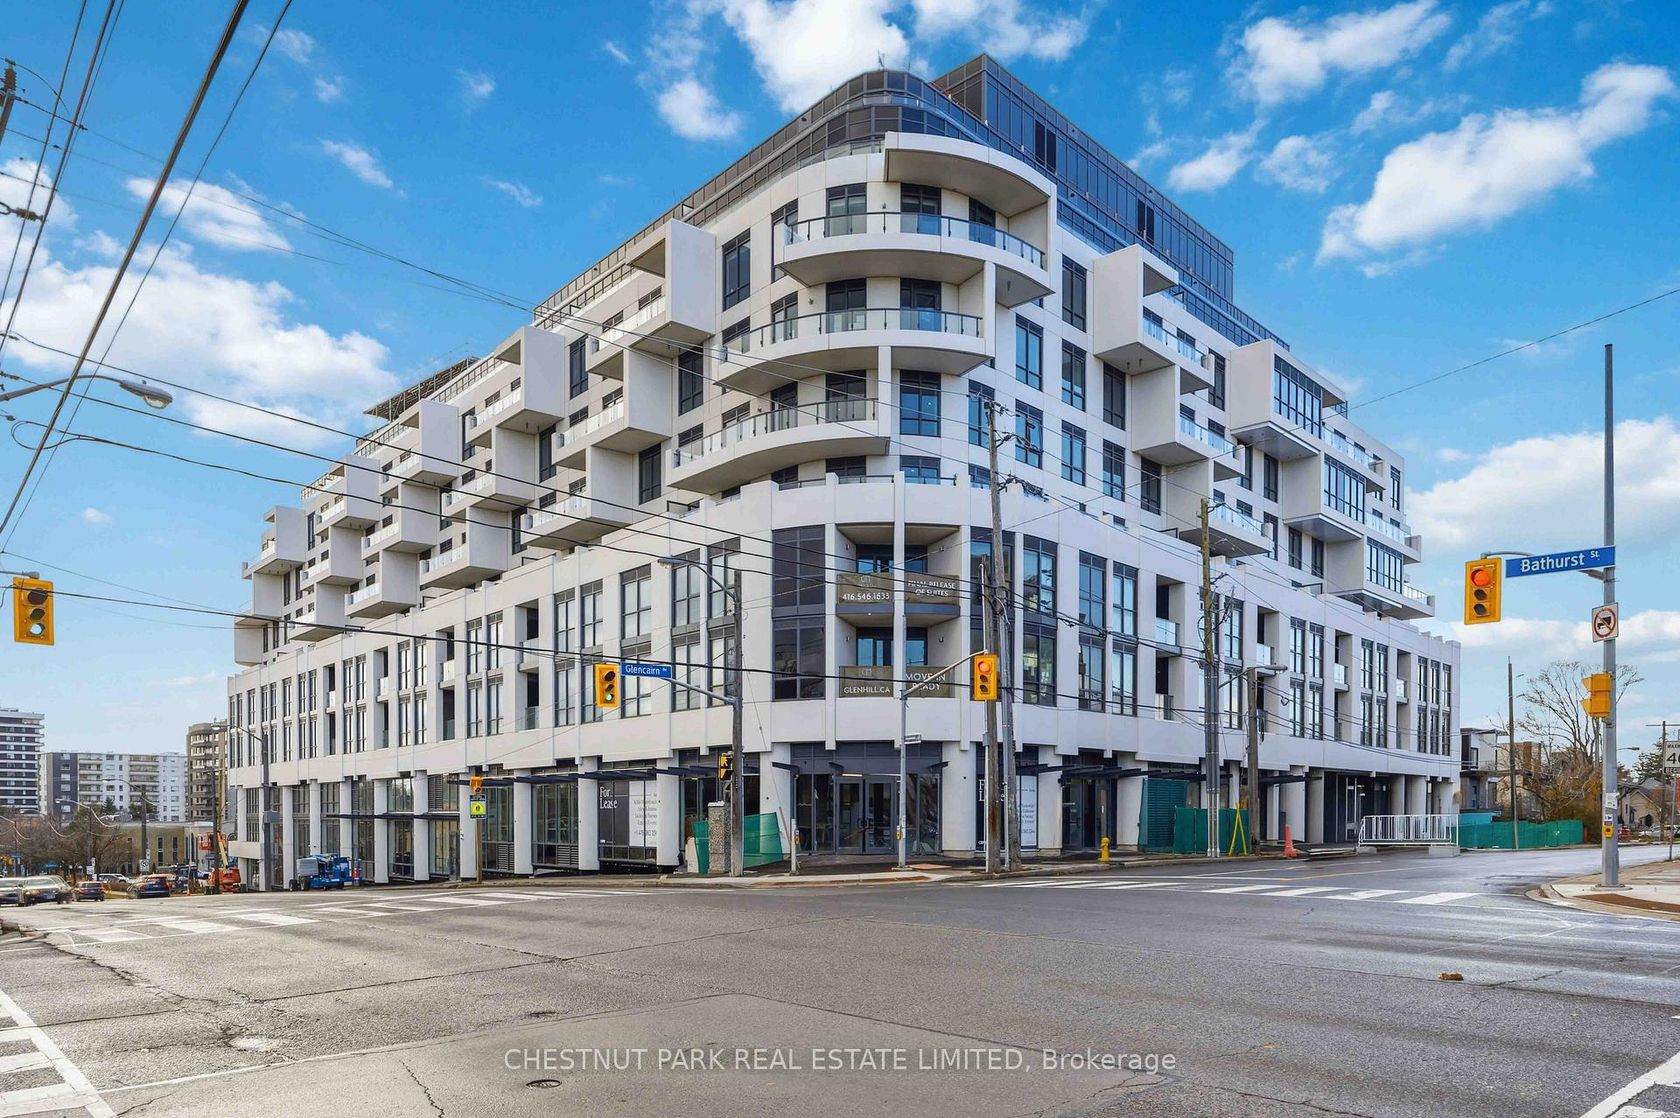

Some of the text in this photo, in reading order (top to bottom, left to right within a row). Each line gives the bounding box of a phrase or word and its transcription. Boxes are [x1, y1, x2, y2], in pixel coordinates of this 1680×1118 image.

[1520, 553, 1584, 572] Bathurst
[625, 665, 660, 675] Glencairn
[843, 686, 891, 694] GLENHILL.CA
[912, 683, 941, 691] RADY
[1666, 752, 1680, 764] 4
[600, 786, 610, 797] For
[600, 798, 618, 809] Lease
